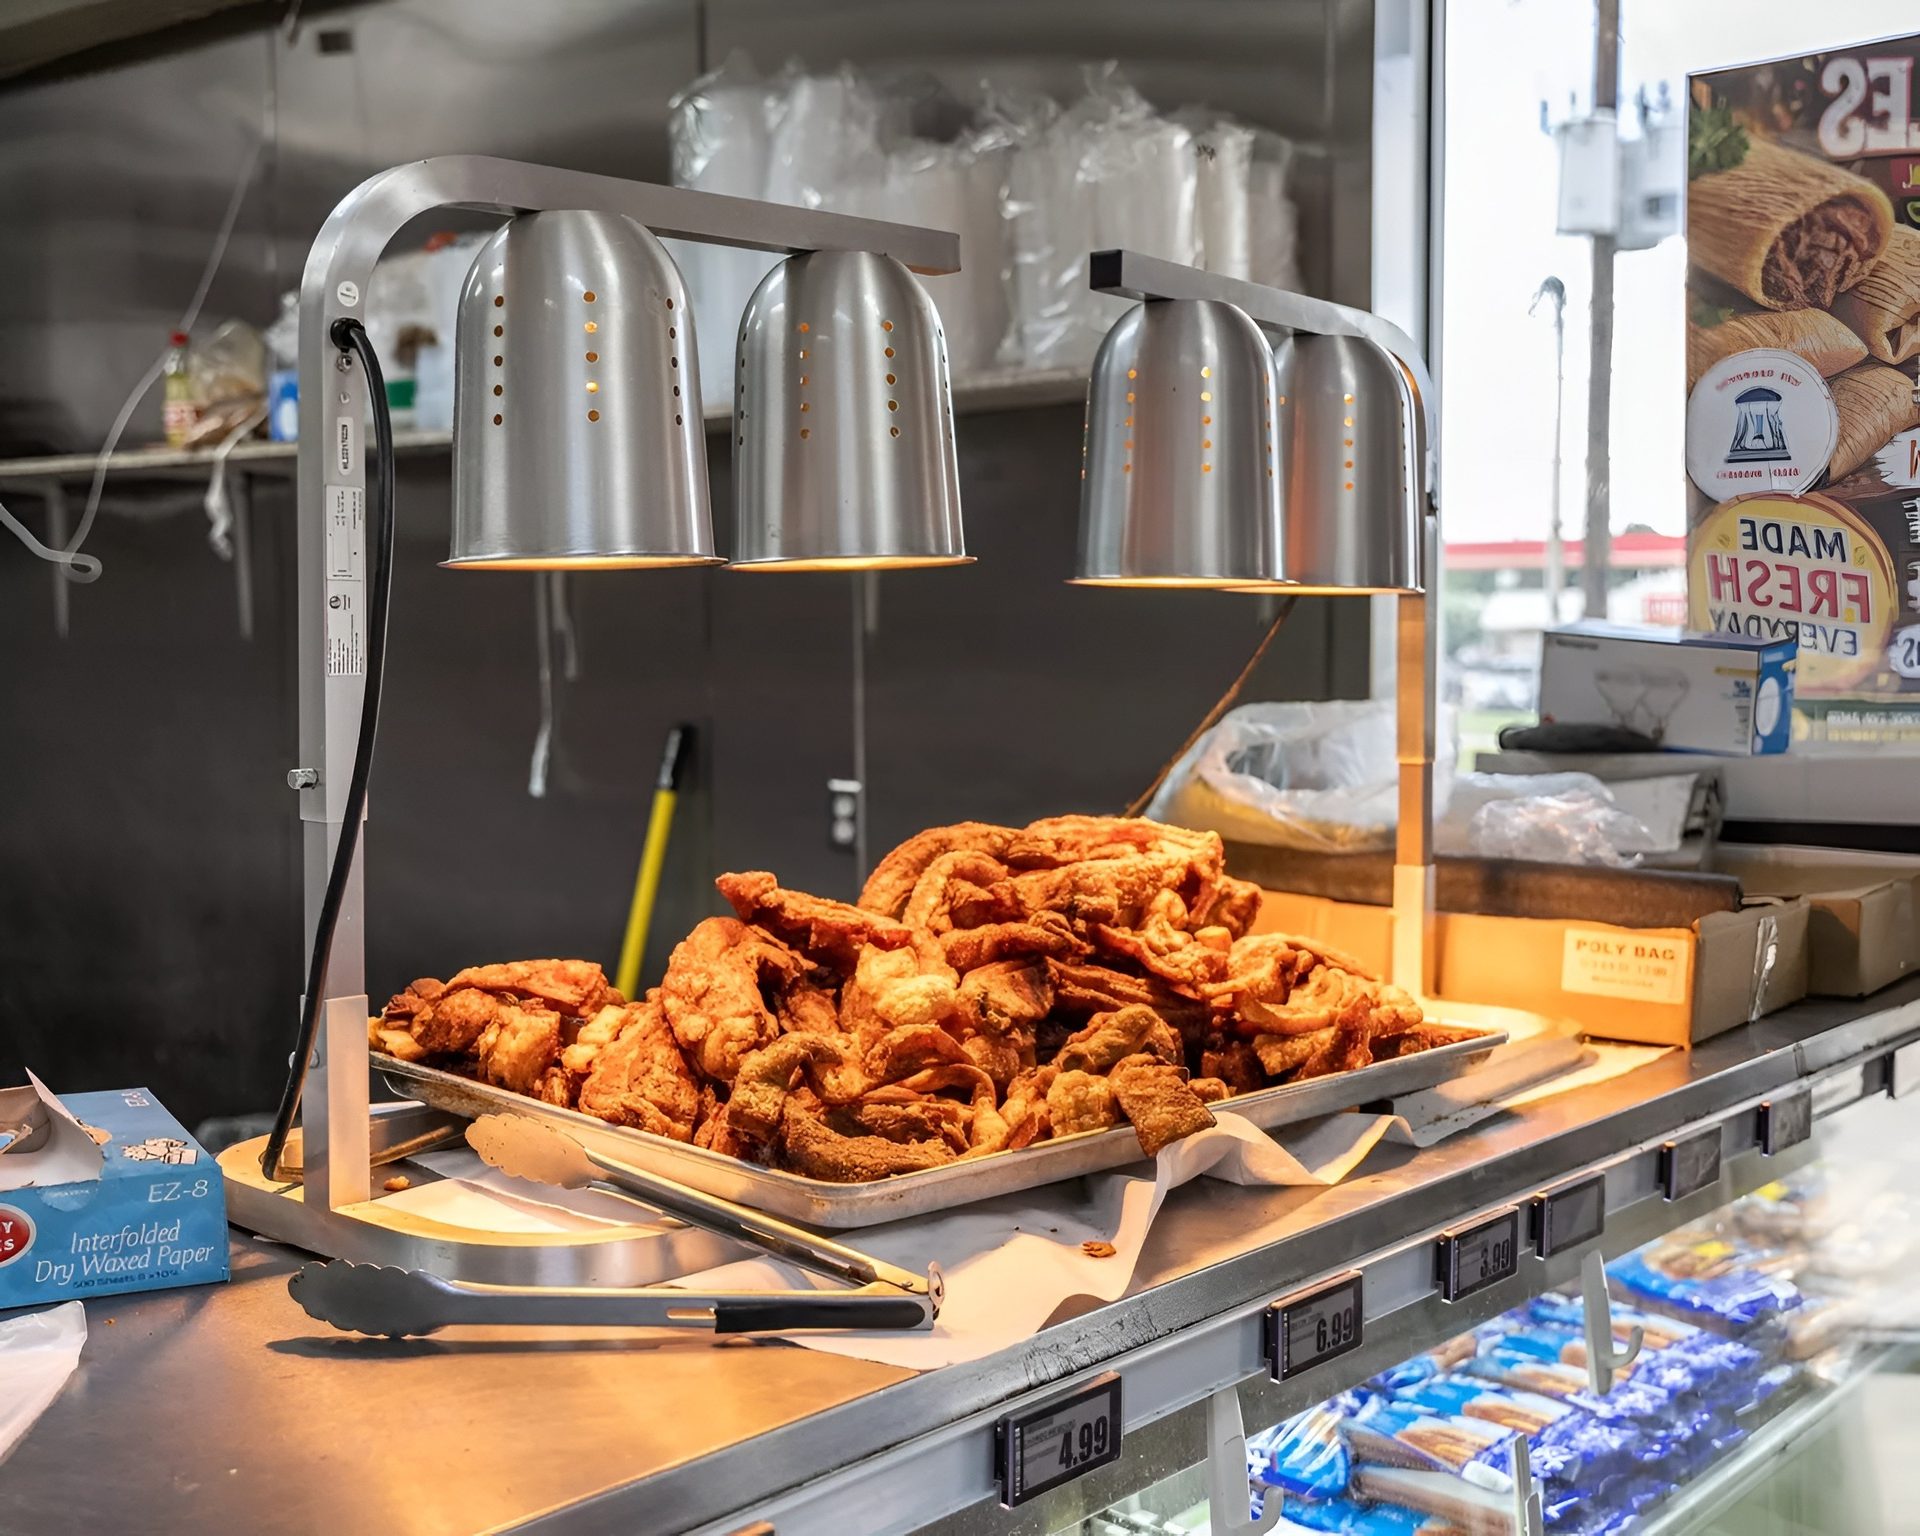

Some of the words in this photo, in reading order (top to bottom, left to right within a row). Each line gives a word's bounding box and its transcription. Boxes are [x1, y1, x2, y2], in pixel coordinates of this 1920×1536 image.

[1575, 939, 1626, 956] POLY
[1634, 945, 1676, 960] BAG
[148, 1179, 209, 1203] EZ-8
[71, 1218, 181, 1254] Interfolded
[35, 1260, 75, 1286] Dry
[82, 1248, 151, 1276] Waxed
[157, 1245, 214, 1270] Paper
[1480, 1239, 1509, 1278] 3.99
[1317, 1307, 1352, 1353] 6.99
[1058, 1415, 1108, 1469] 4.99
